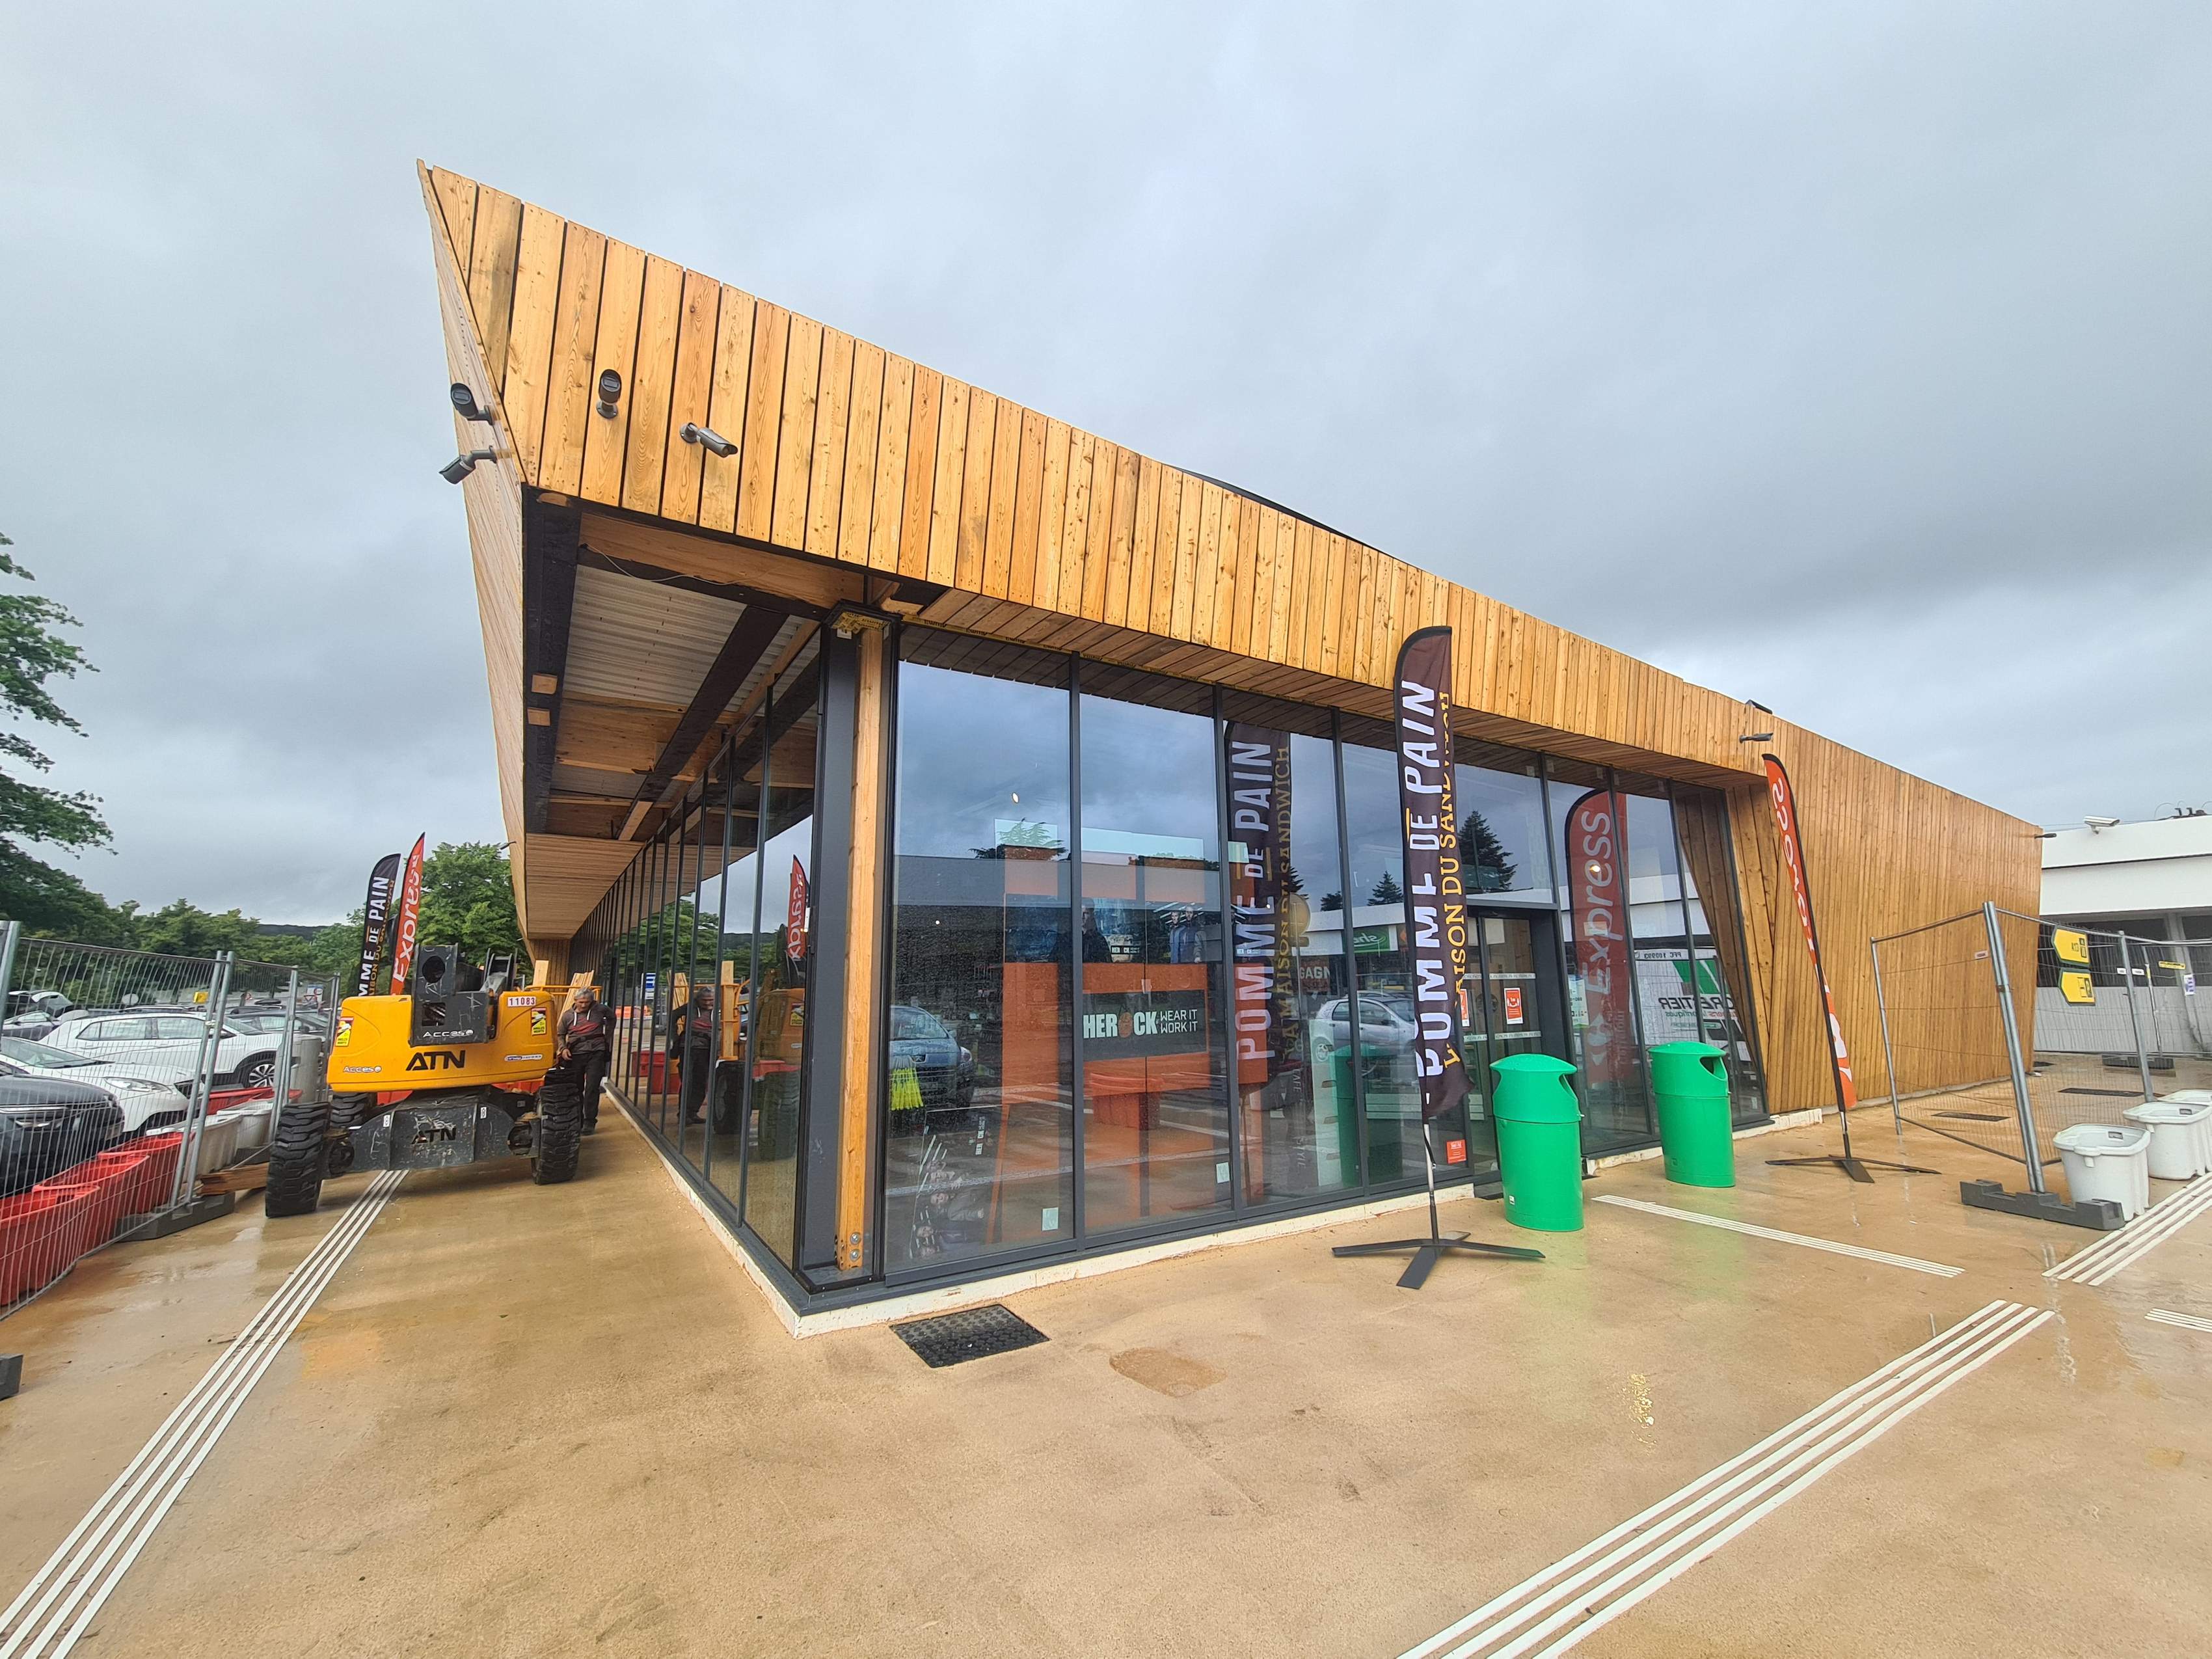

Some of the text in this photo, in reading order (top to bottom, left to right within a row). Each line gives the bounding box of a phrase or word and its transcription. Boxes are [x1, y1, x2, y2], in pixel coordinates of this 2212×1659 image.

[1401, 680, 1443, 794] PAIN
[1232, 741, 1273, 832] PAIN
[1275, 747, 1291, 874] SANDWICH
[1410, 813, 1440, 850] DE
[1244, 848, 1263, 878] DE
[1440, 856, 1462, 897] DU
[1582, 811, 1623, 995] Express
[358, 876, 390, 997] MME DE PAIN
[1444, 903, 1466, 995] AISON
[368, 964, 379, 997] AISON
[1235, 895, 1276, 1060] POMME
[1277, 920, 1299, 1018] MAISON
[509, 997, 535, 1006] 11083
[1160, 1009, 1198, 1021] WEAR IT
[1160, 1021, 1198, 1034] WORK IT
[406, 1050, 466, 1072] ATN
[412, 1127, 456, 1144] ATN
